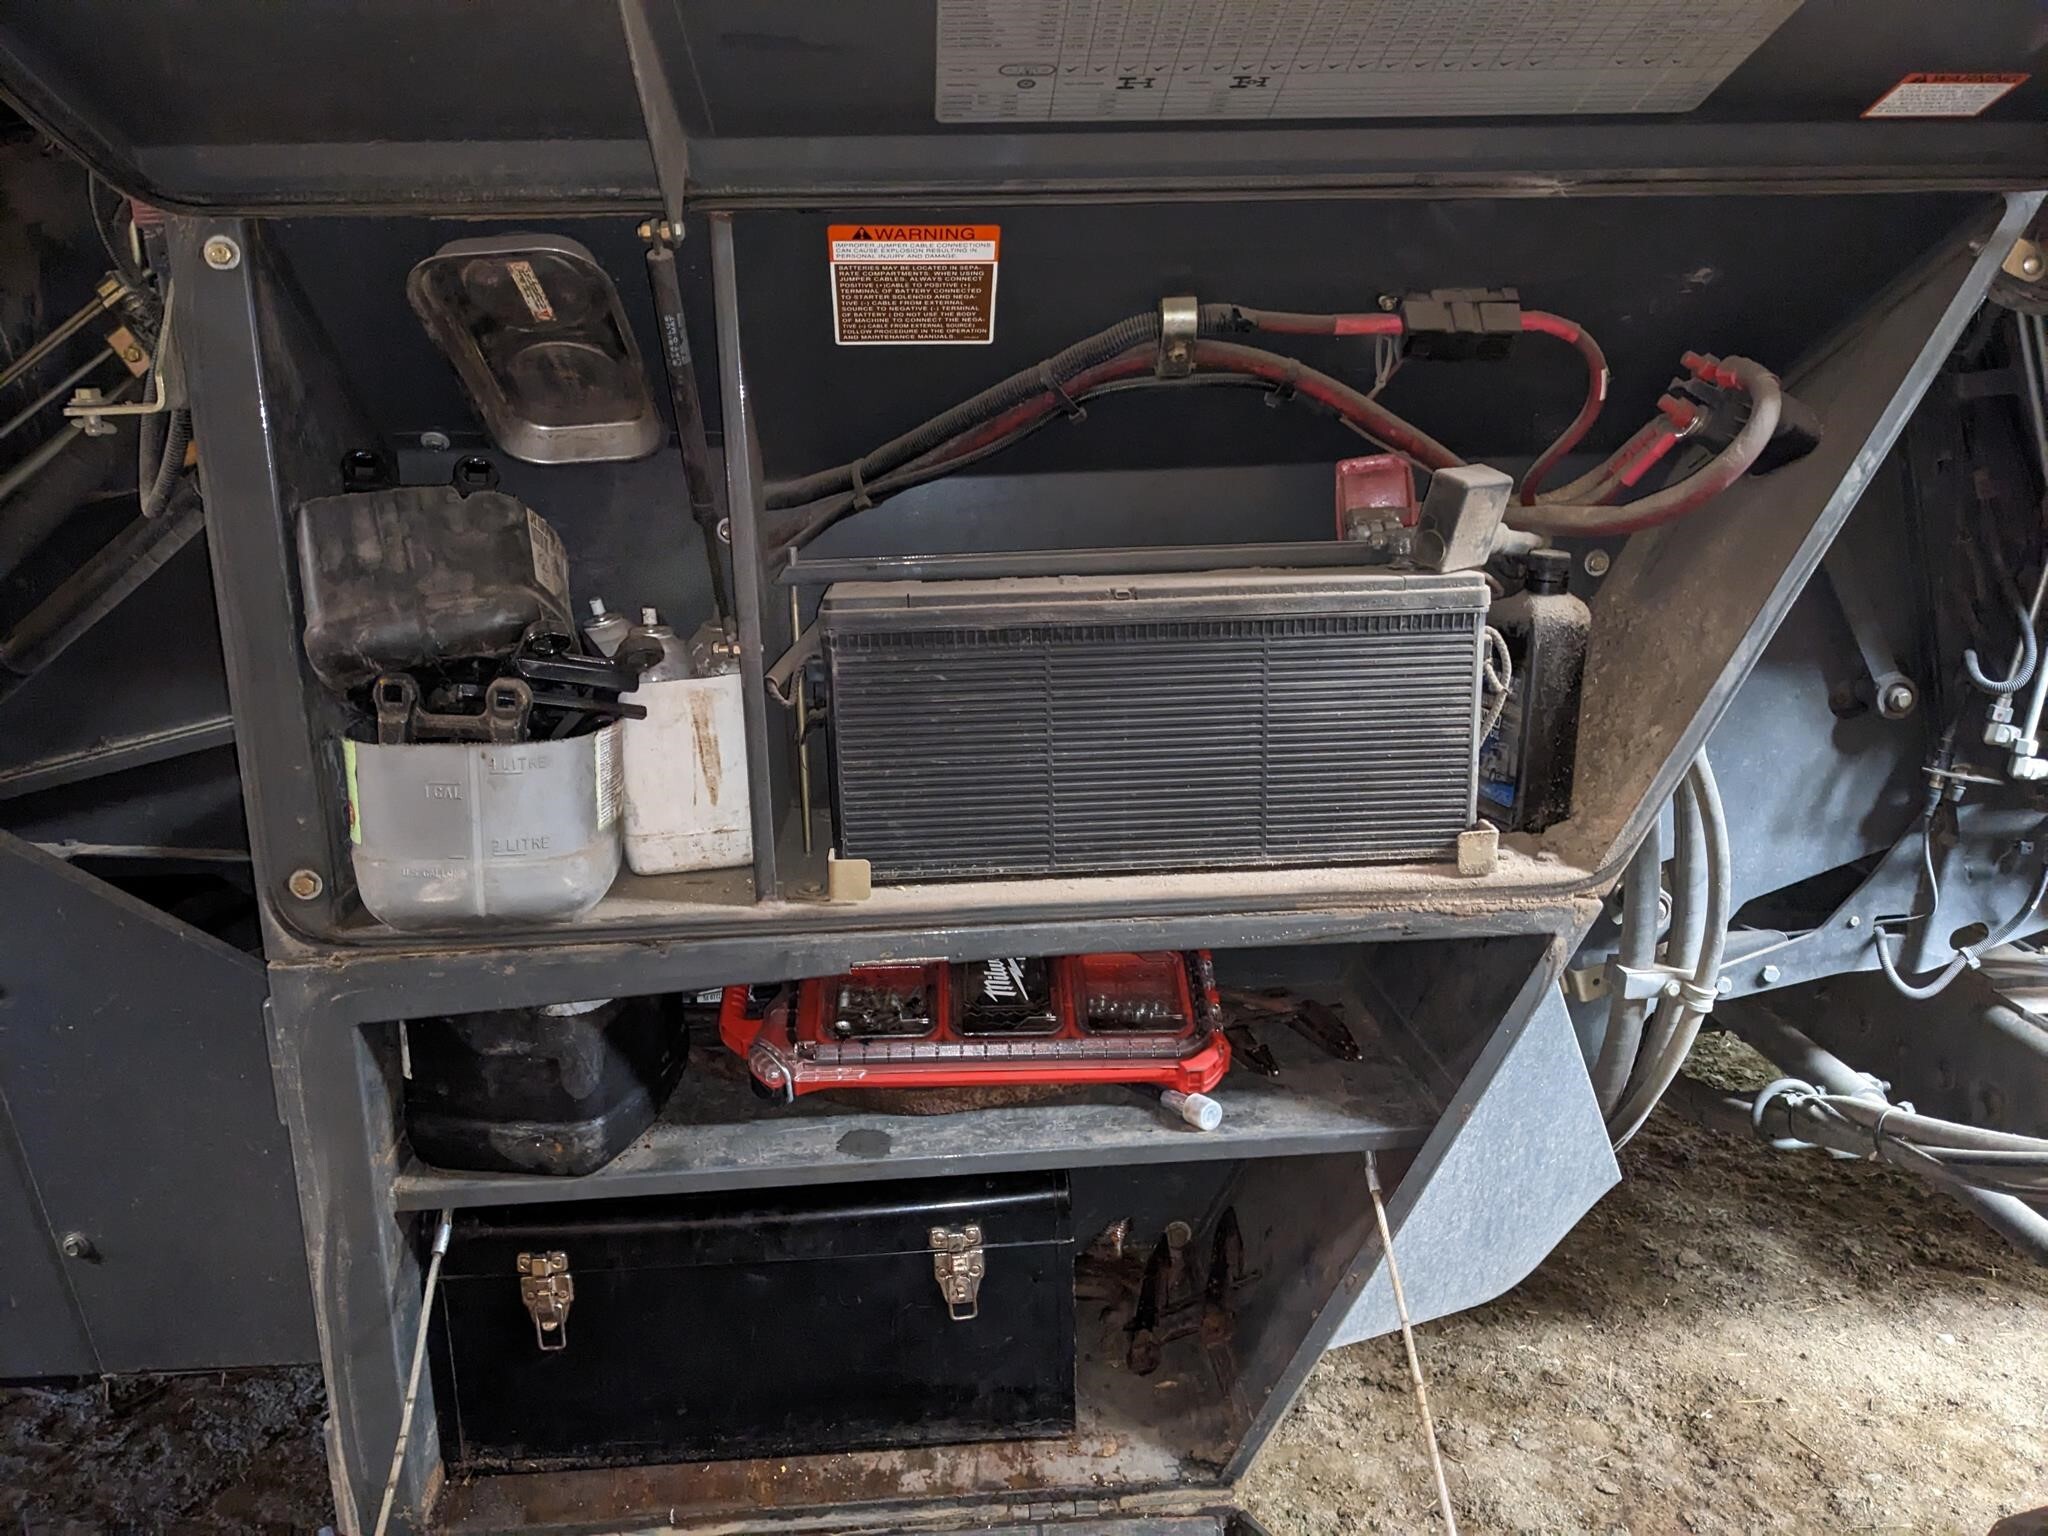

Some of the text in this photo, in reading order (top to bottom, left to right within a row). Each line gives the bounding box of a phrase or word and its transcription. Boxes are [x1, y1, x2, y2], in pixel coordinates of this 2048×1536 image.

[875, 228, 975, 240] WARNING
[502, 756, 548, 771] LITRE
[506, 836, 551, 852] LITRE
